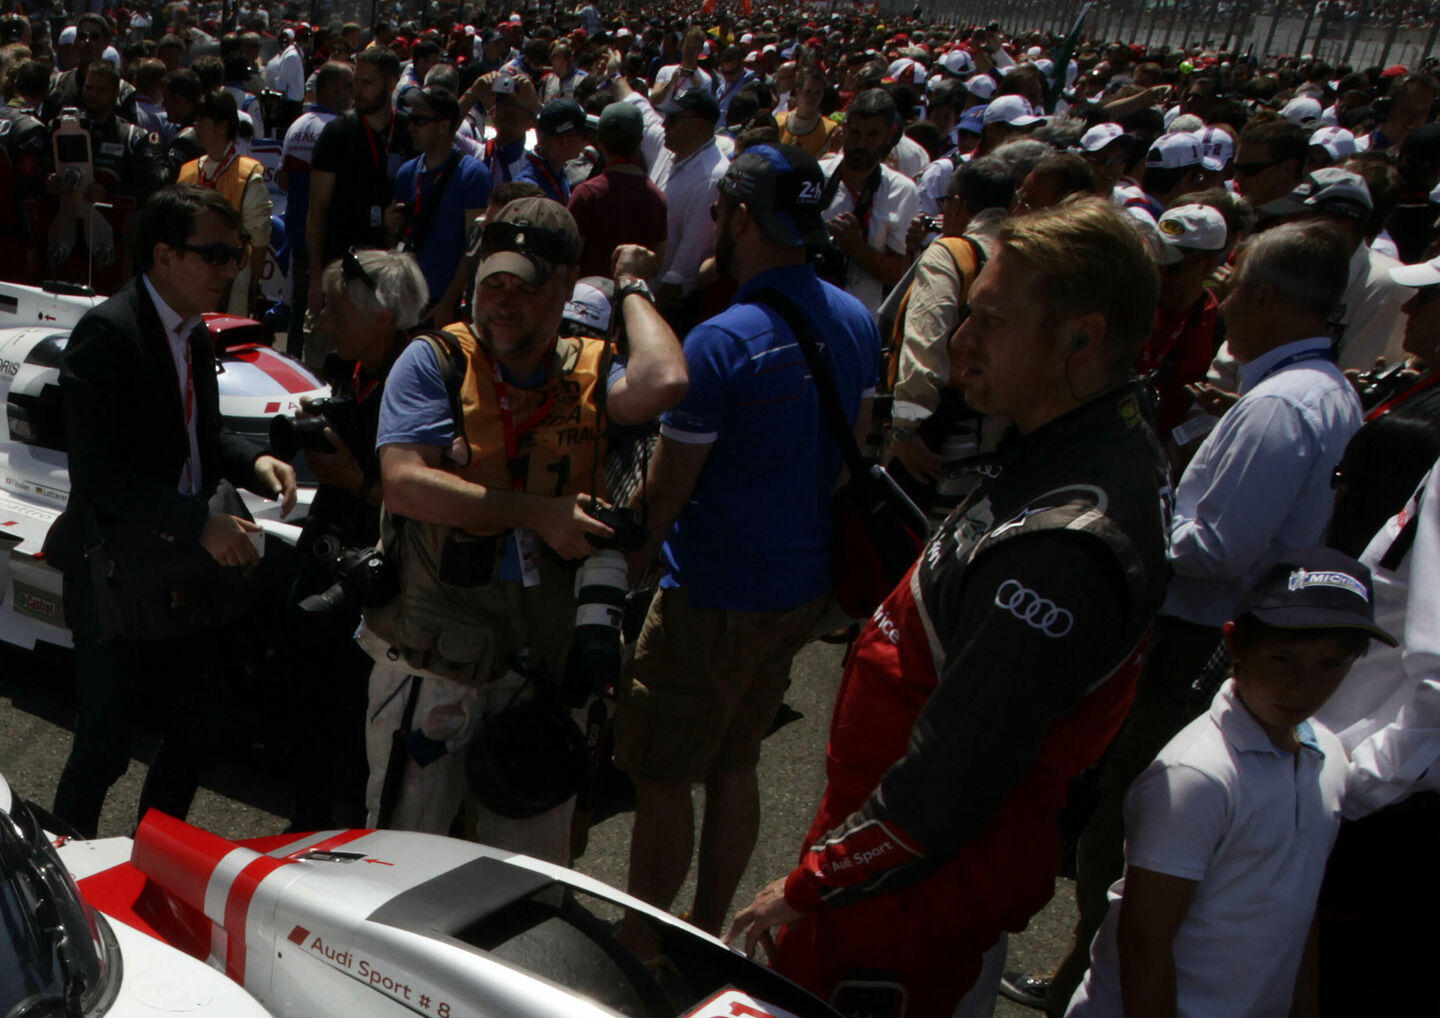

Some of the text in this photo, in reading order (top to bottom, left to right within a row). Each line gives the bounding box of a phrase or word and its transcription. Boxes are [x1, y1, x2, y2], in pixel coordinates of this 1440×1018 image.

[853, 841, 895, 866] Sport
[311, 937, 353, 969] Audi
[357, 959, 412, 1000] Sport
[418, 994, 432, 1009] #
